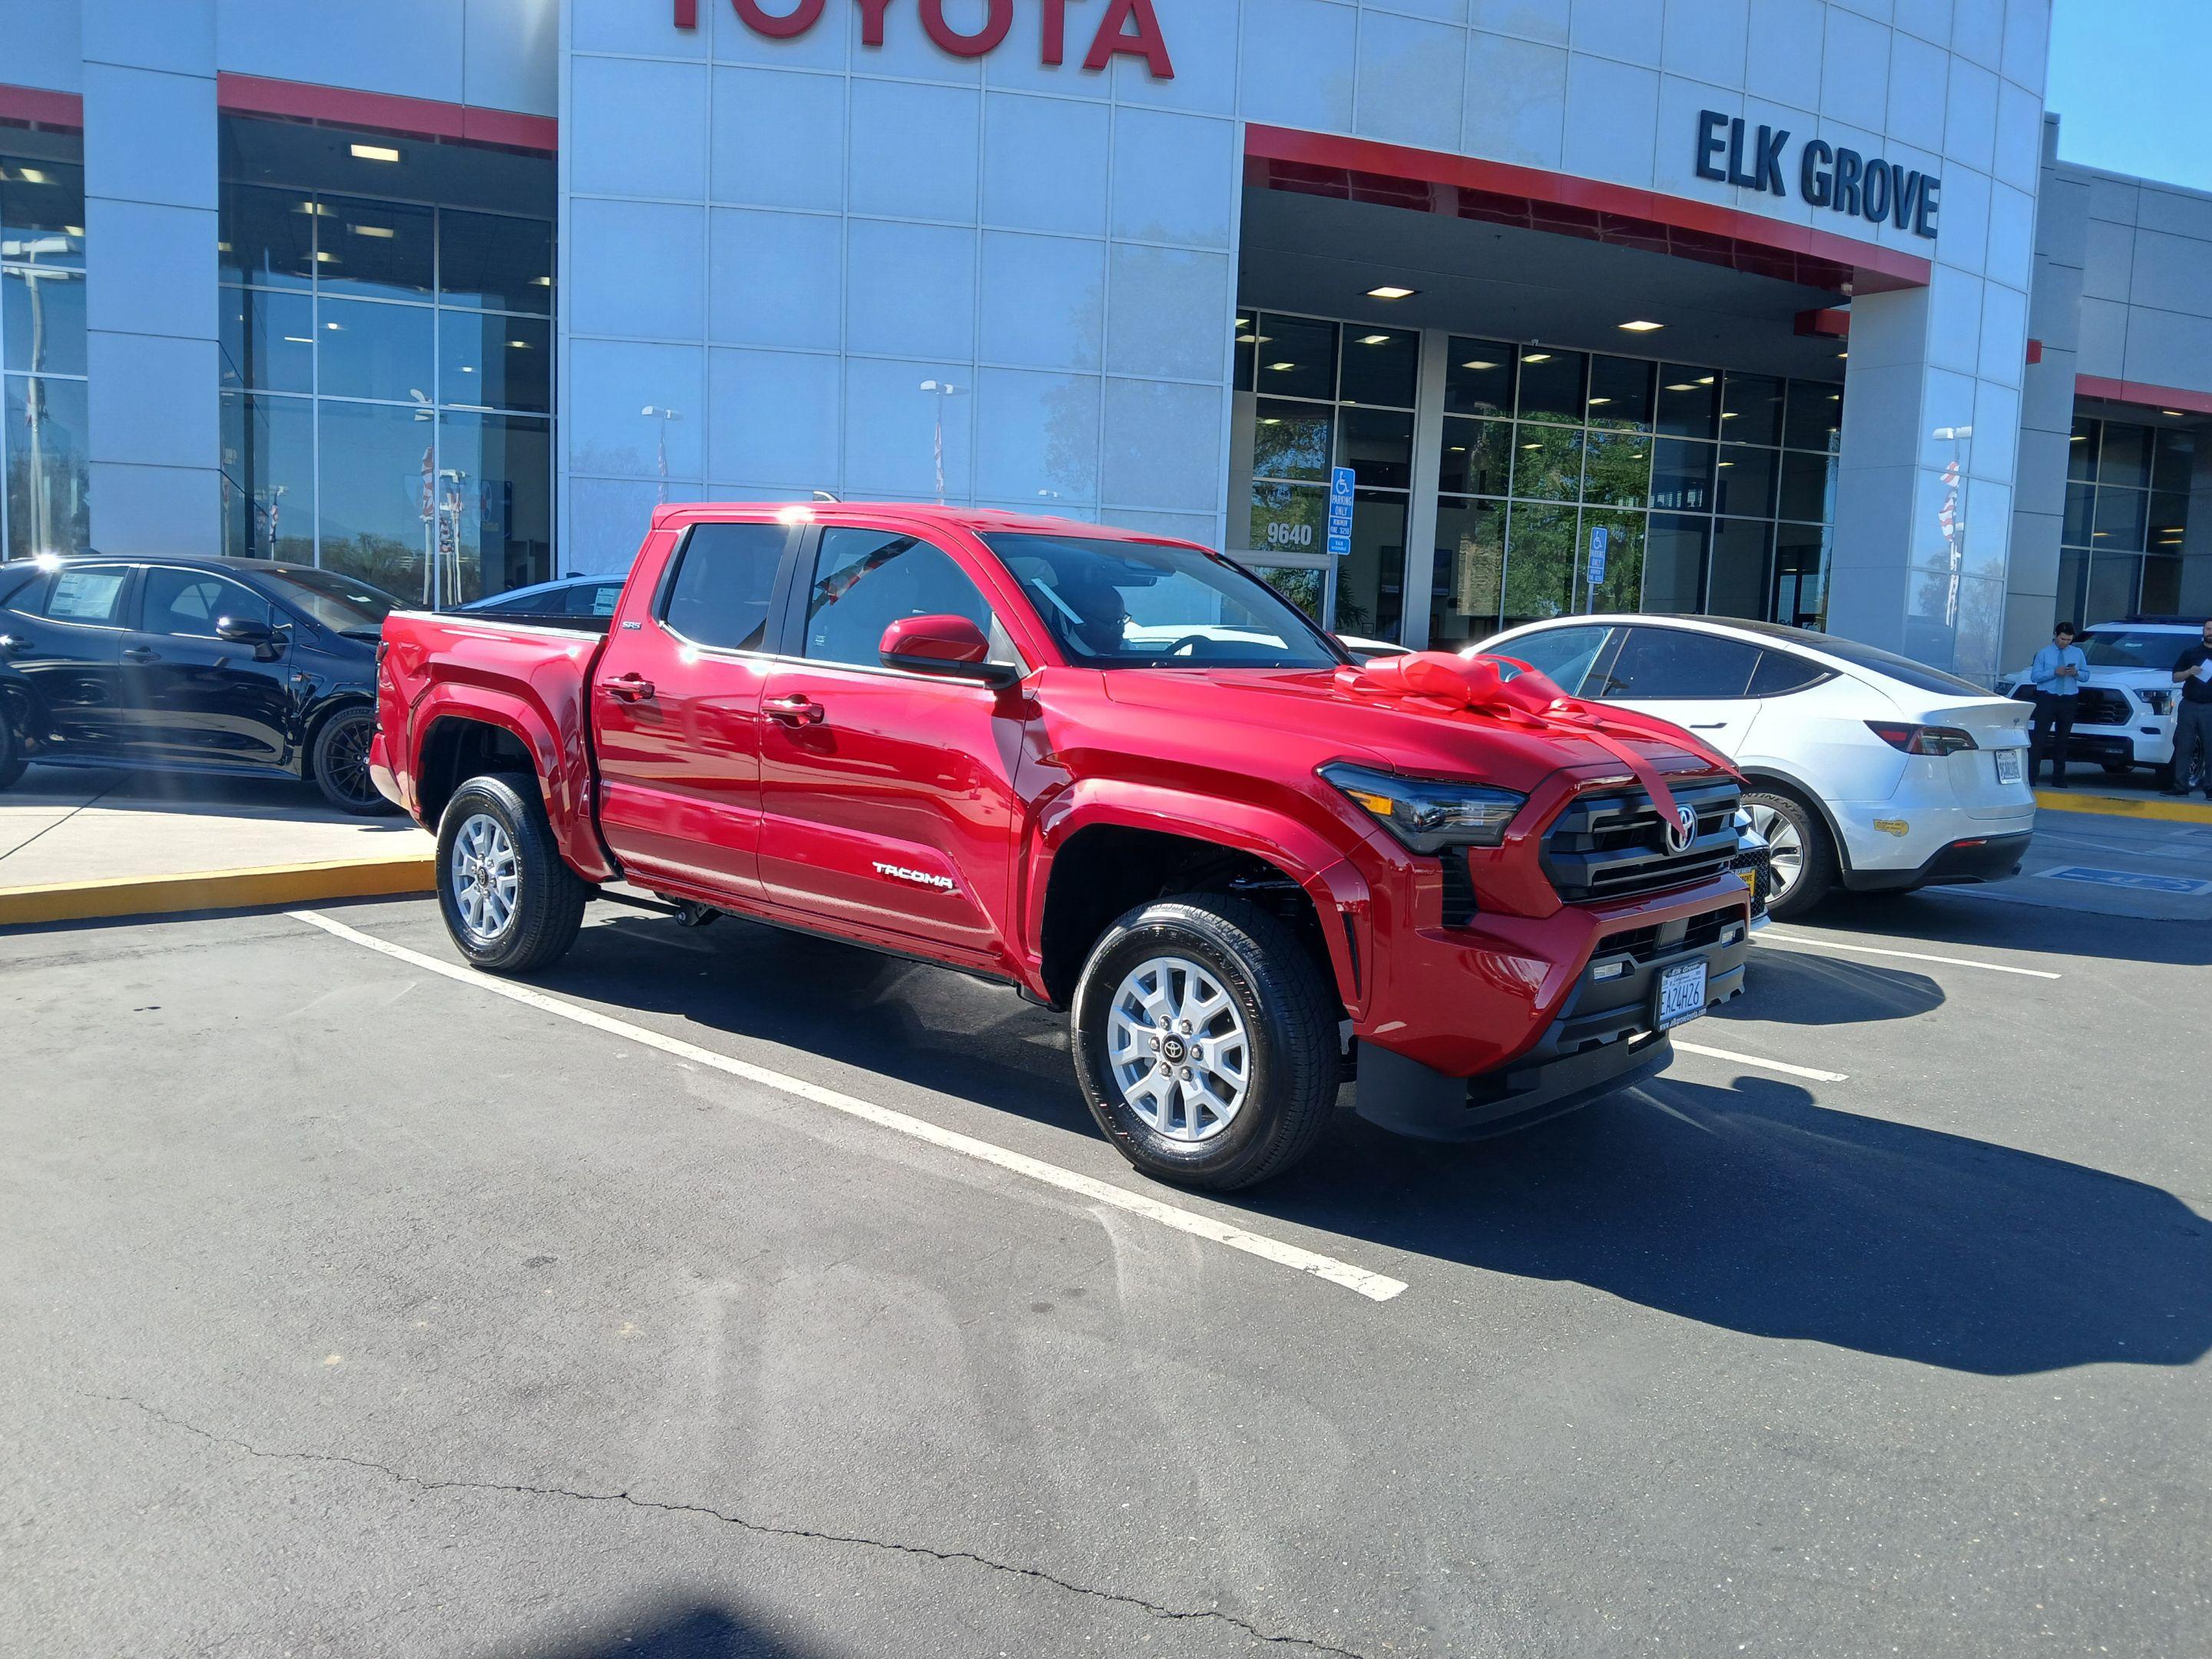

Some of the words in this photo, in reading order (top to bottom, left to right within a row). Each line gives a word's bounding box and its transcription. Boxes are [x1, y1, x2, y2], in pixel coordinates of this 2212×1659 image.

[1697, 109, 1790, 197] ELK
[1801, 139, 1941, 239] GROVE
[1332, 495, 1352, 506] PARKING
[1335, 505, 1348, 516] ONLY
[1267, 522, 1312, 545] 9640
[873, 861, 953, 889] TACOMA
[1671, 968, 1682, 976] Elk
[1661, 981, 1700, 1015] EA24H26
